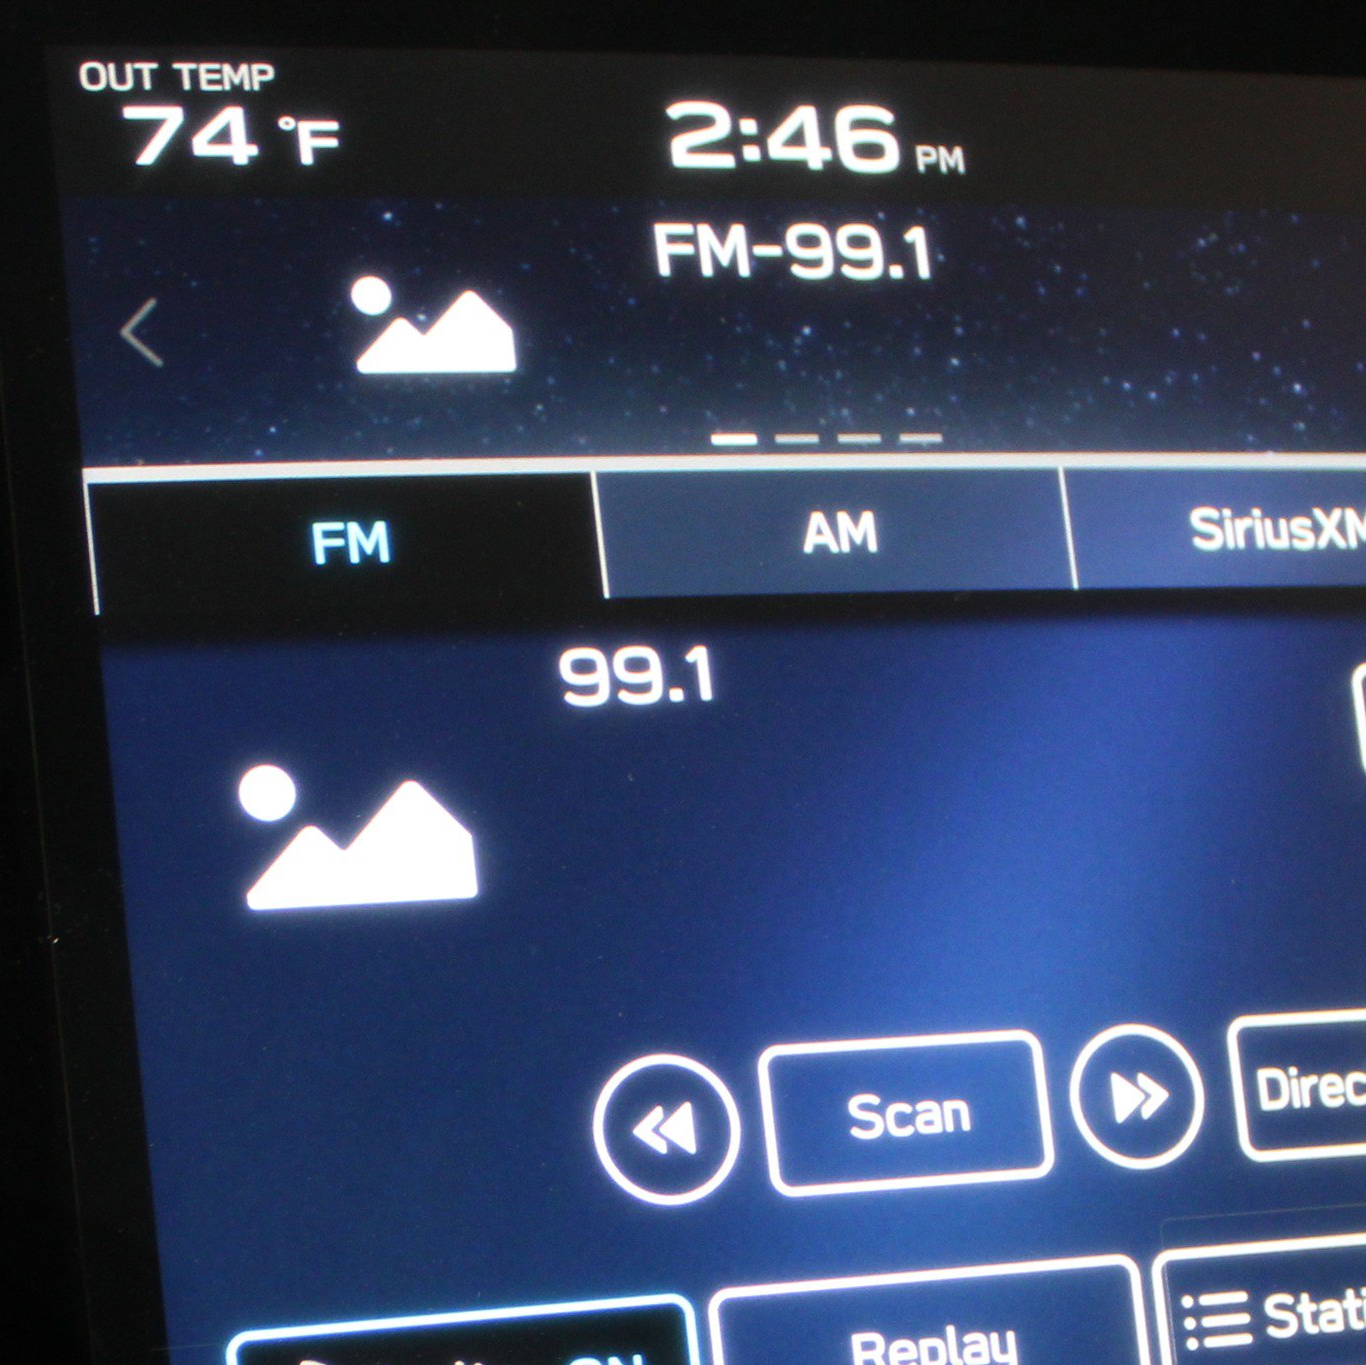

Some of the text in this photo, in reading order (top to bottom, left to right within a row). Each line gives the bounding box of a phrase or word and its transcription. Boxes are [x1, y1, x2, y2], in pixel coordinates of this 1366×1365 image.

[79, 61, 275, 92] OUT TEMP
[122, 105, 259, 166] 74
[665, 100, 965, 174] 2:46 PM
[653, 222, 931, 281] FM-99.1
[312, 520, 390, 565] FM
[803, 510, 878, 554] AM
[558, 645, 713, 708] 99.1
[847, 1093, 972, 1141] Scan
